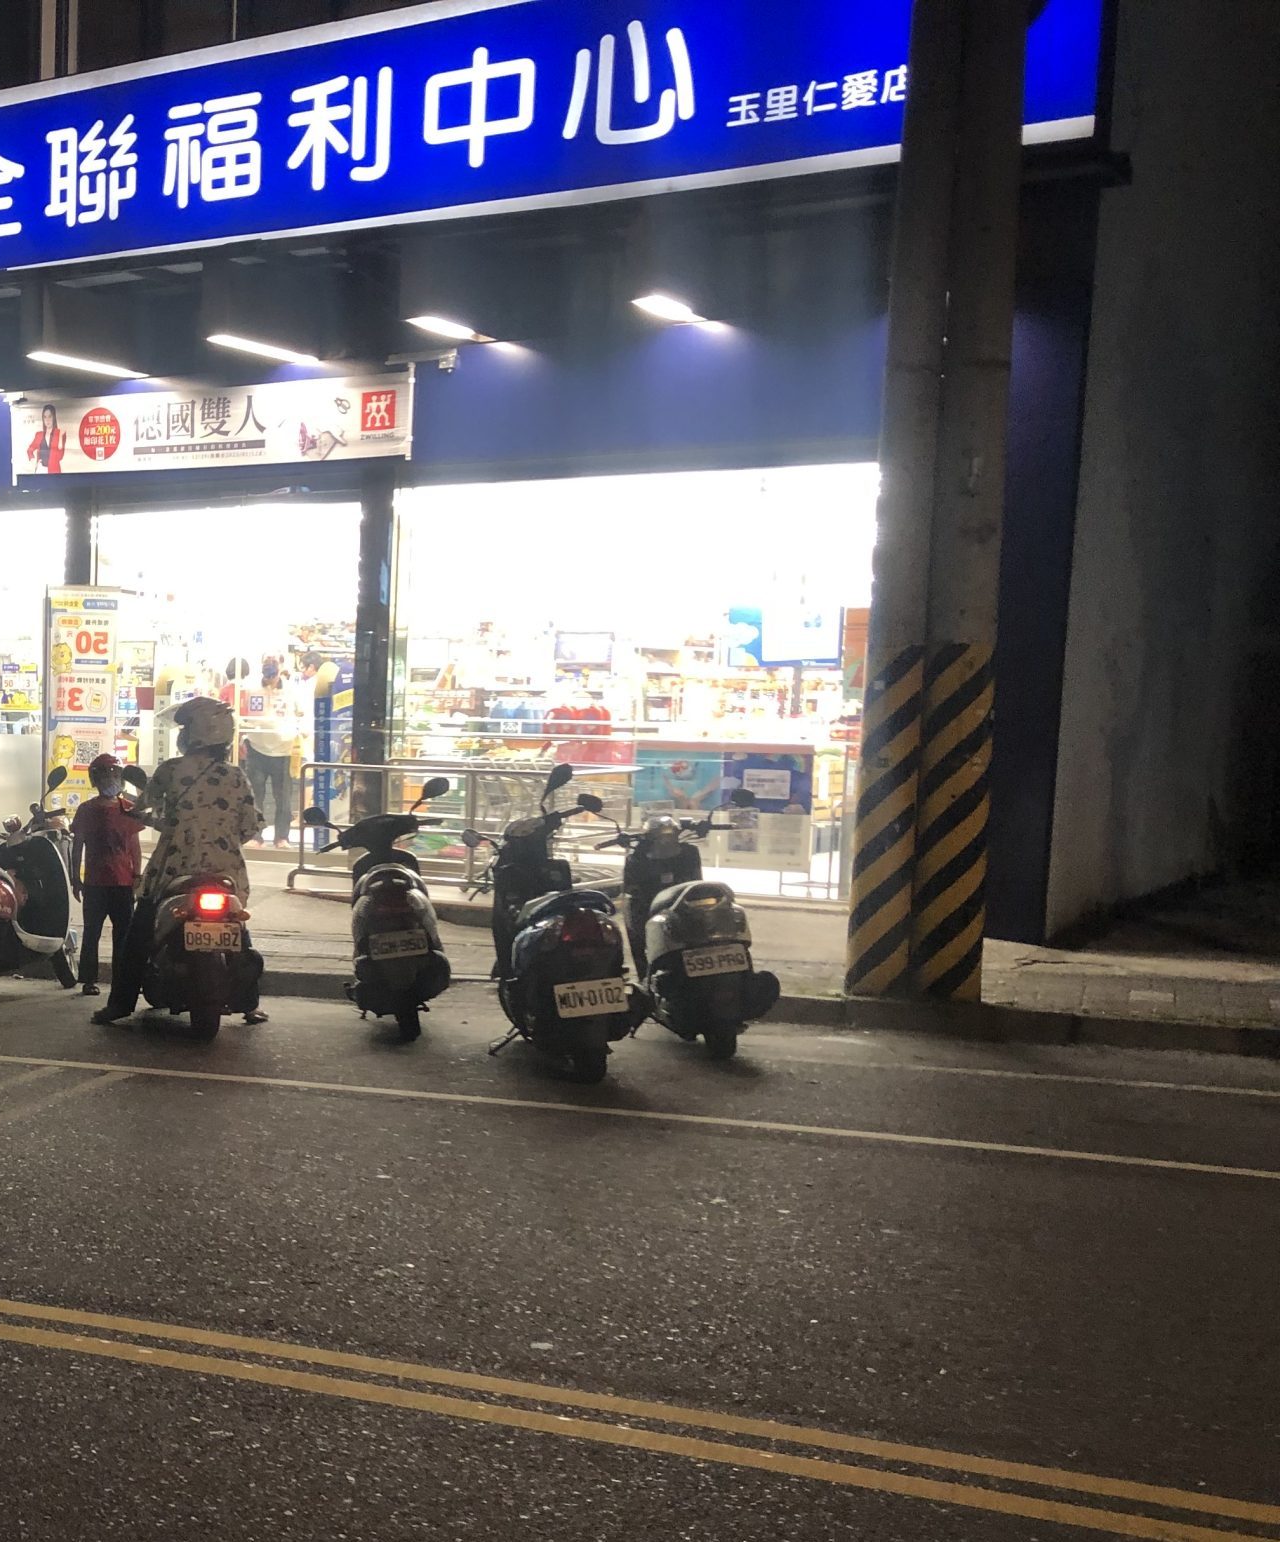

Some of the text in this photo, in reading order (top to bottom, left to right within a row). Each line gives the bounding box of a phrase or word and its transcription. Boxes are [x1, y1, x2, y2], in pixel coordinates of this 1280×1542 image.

[726, 64, 907, 127] 玉里仁愛店
